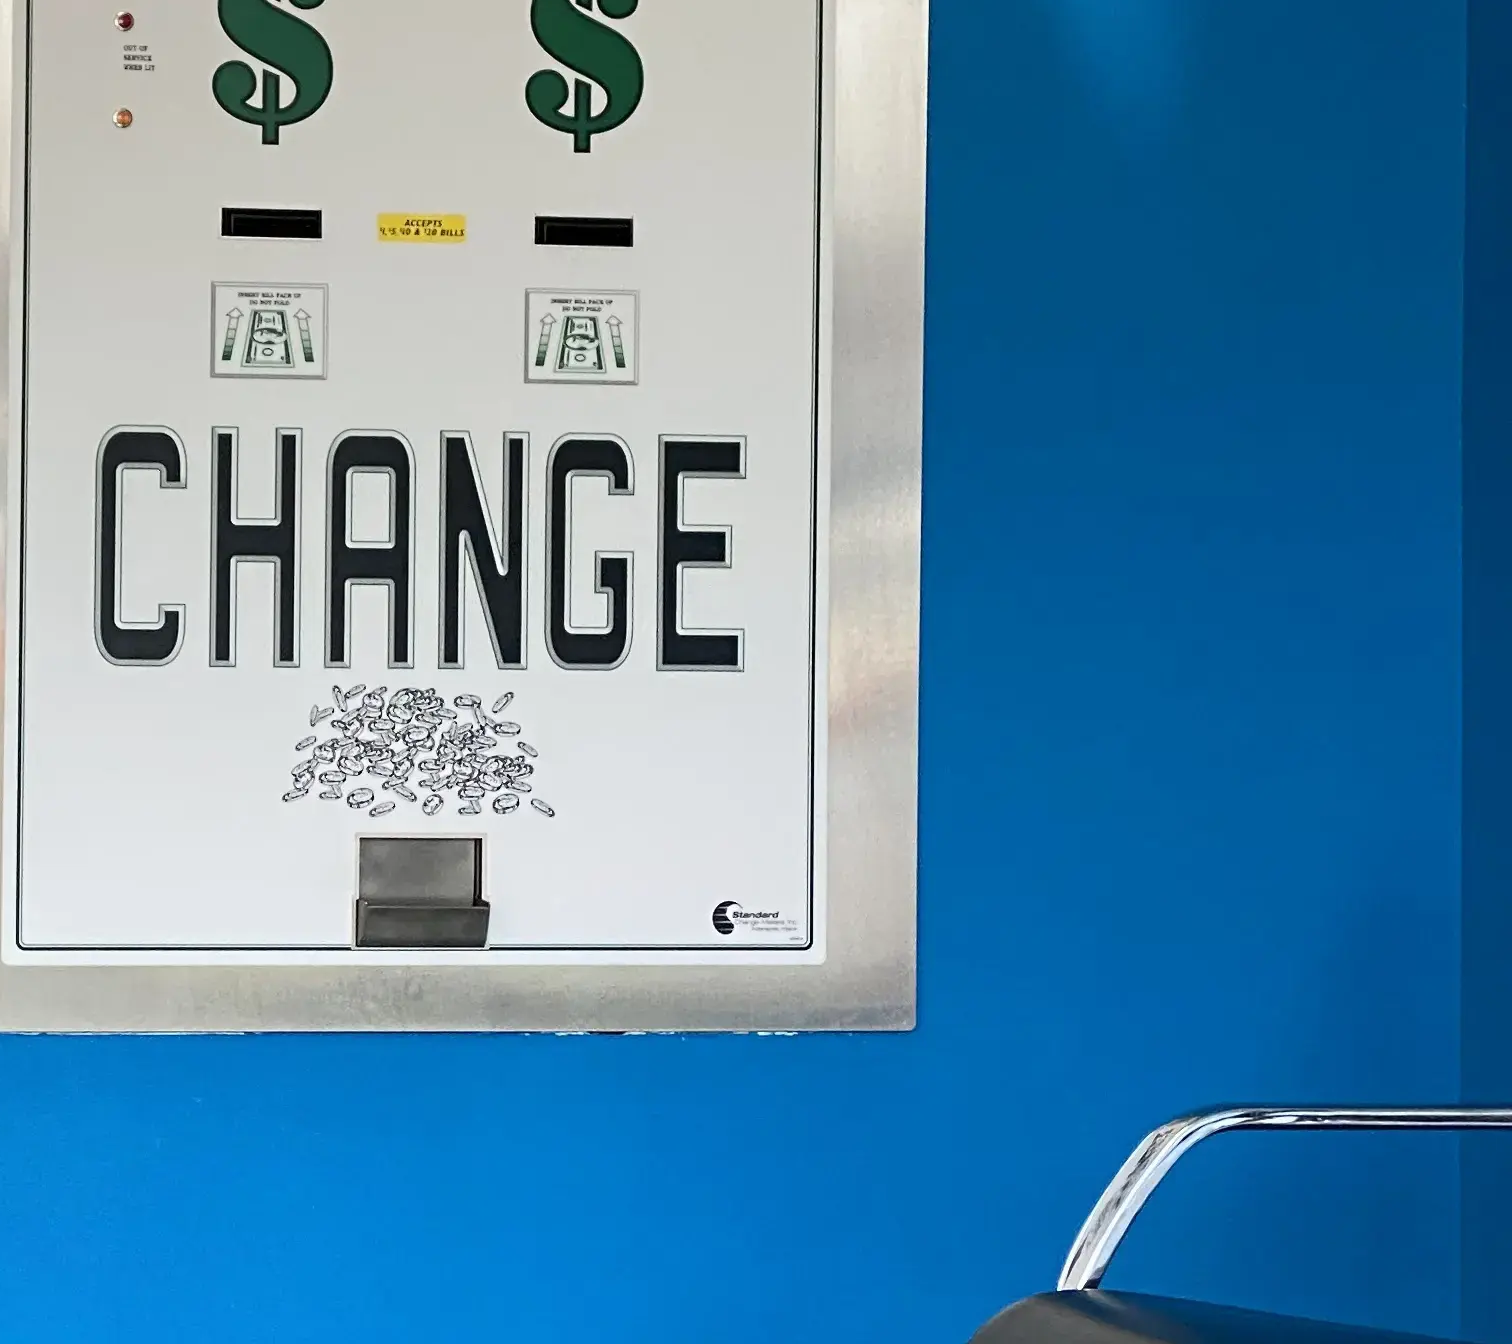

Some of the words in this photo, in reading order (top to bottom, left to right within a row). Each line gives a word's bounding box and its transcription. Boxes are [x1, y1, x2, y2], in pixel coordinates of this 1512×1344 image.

[404, 219, 443, 228] ACCEPTS
[440, 229, 465, 237] BILLS
[92, 424, 748, 673] CHANGE
[732, 911, 780, 919] Standard
